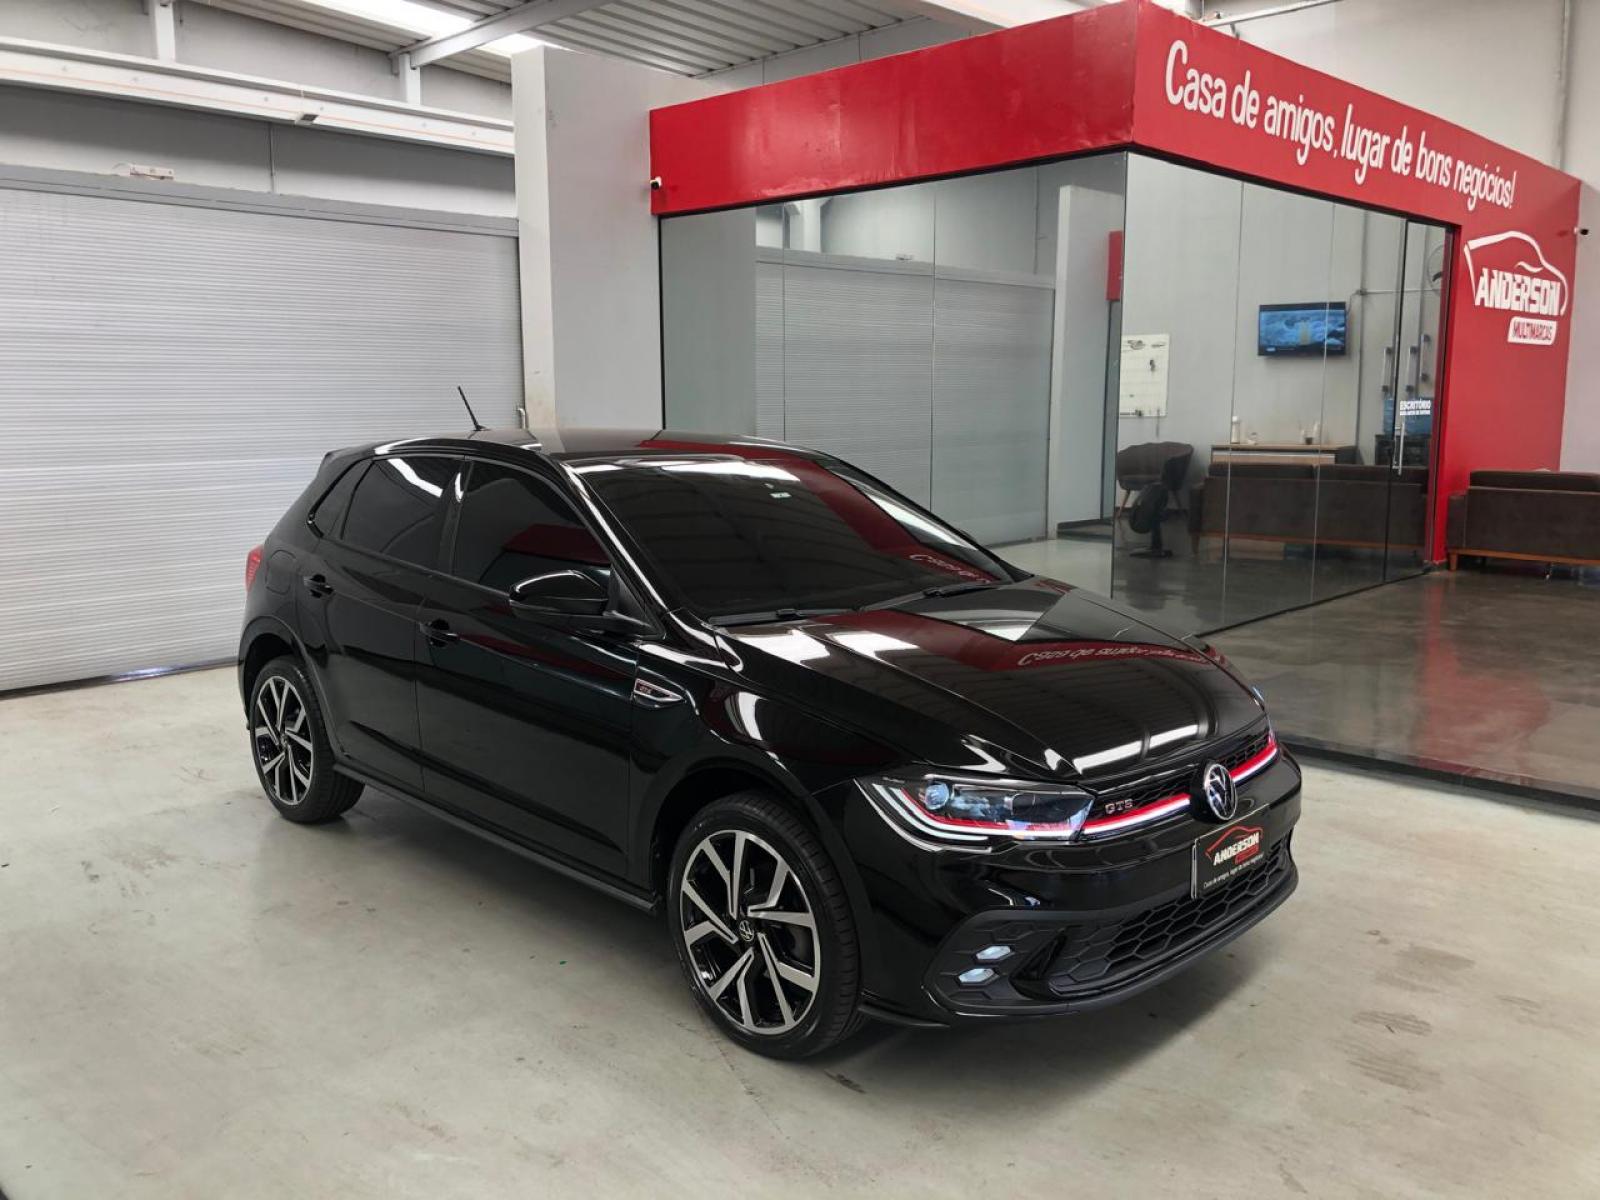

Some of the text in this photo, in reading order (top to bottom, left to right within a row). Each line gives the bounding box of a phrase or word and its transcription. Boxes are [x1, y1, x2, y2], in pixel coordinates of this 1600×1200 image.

[1165, 39, 1517, 211] Casa de amigos, lugar de bons negócios!
[1475, 267, 1561, 316] ANDERSON
[1512, 320, 1553, 341] MULTIMARCAS
[1212, 831, 1260, 867] ANDERSON
